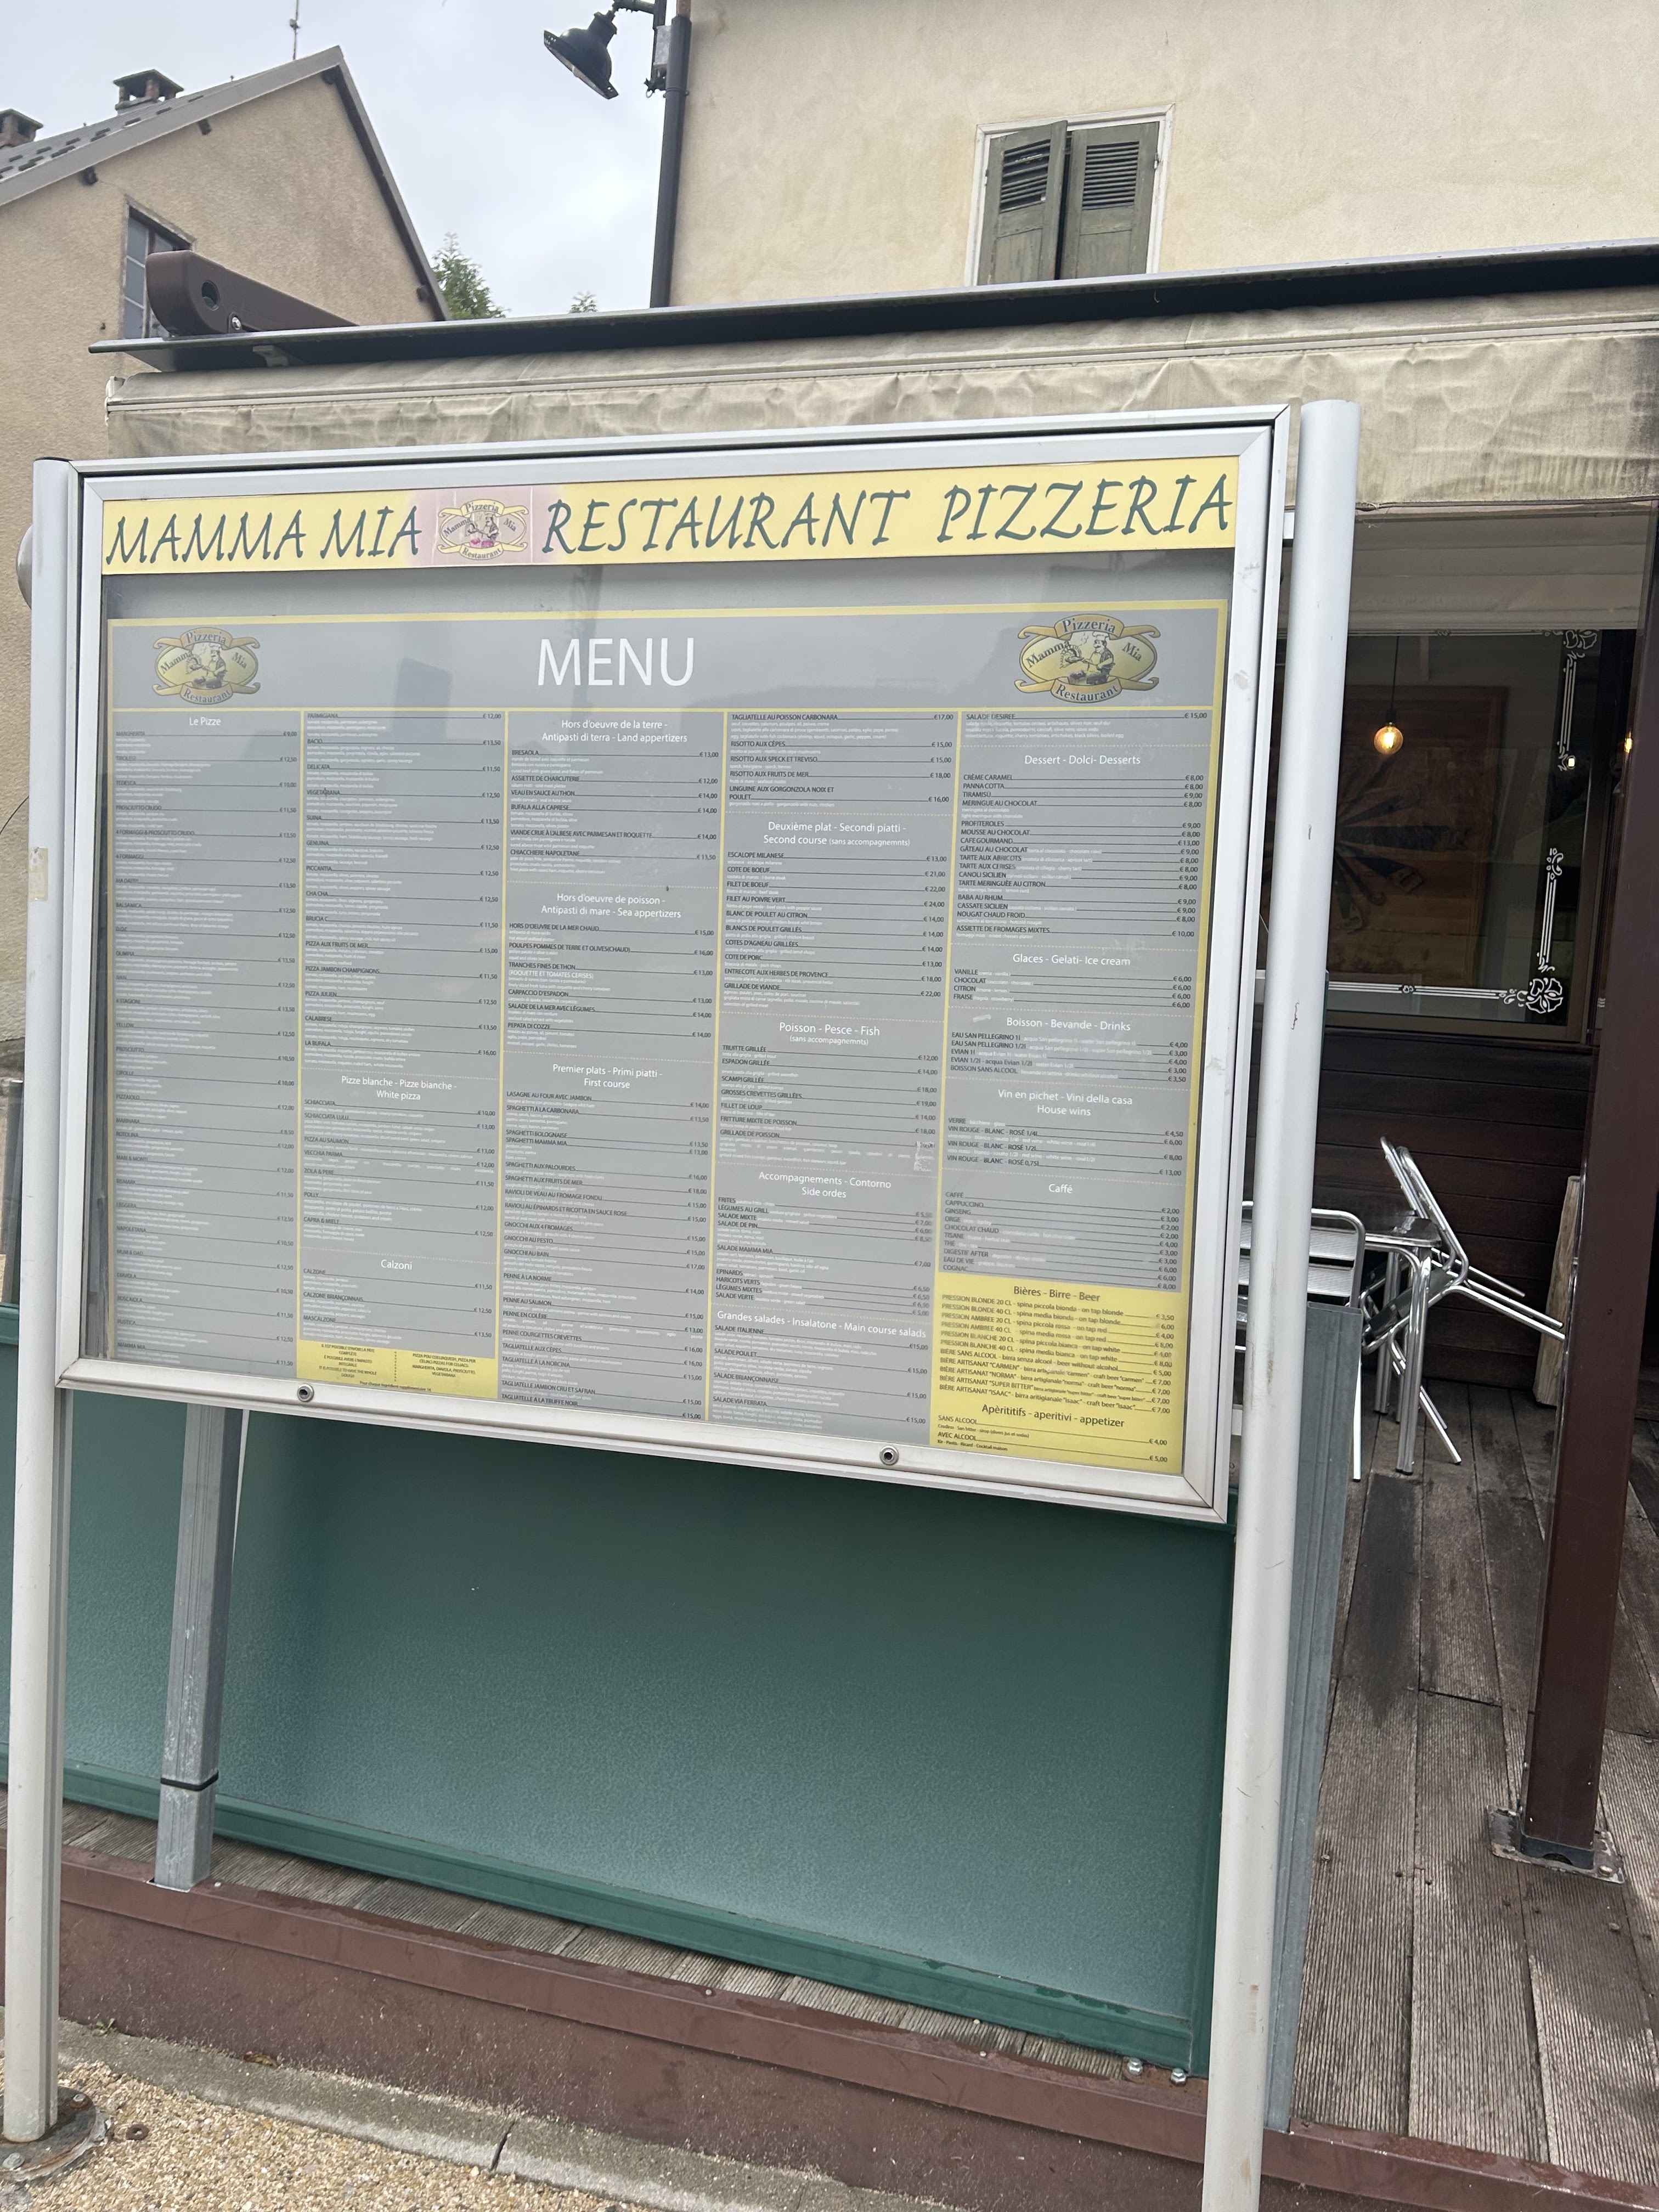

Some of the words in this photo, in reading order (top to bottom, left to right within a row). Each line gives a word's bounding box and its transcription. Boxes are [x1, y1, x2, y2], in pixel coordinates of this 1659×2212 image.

[465, 503, 499, 512] Pizzeria
[541, 488, 911, 554] RESTAURANT
[937, 473, 1233, 543] PIZZERIA
[443, 517, 473, 537] Mamma
[504, 517, 516, 532] Mia
[106, 509, 306, 565] MAMMA
[320, 505, 422, 561] MIA
[462, 548, 501, 558] Restaurant
[1062, 618, 1116, 633] Pizzeria
[186, 631, 226, 644] Pizzeria
[1025, 640, 1071, 668] Mamma
[1122, 642, 1142, 661] Mia
[160, 651, 194, 674] Mamma
[232, 652, 247, 669] Mia
[538, 637, 694, 686] MENU
[184, 689, 232, 703] Restaurant
[1056, 684, 1119, 701] Restaurant
[189, 717, 199, 725] Le
[200, 718, 222, 726] Pizze
[562, 720, 581, 729] Hors
[620, 720, 631, 729] de
[634, 720, 641, 729] la
[542, 733, 579, 742] Antipasti
[581, 733, 589, 741] di
[618, 733, 638, 742] Land
[640, 734, 688, 743] appertizers
[1025, 755, 1060, 765] Dessert
[1099, 755, 1141, 765] Desserts
[768, 822, 813, 832] Deuxième
[815, 822, 832, 832] plat
[840, 823, 875, 833] Secondi
[877, 823, 901, 833] piatti
[764, 835, 796, 845] Second
[798, 837, 827, 845] course
[557, 893, 576, 902] Hors
[616, 895, 627, 903] de
[628, 895, 661, 905] poisson
[541, 906, 578, 915] Antipasti
[618, 908, 633, 916] Sea
[634, 909, 681, 918] appertizers
[1013, 954, 1043, 963] Glaces
[1085, 956, 1098, 965] Ice
[1101, 958, 1131, 966] cream
[780, 1022, 816, 1033] Poisson
[825, 1024, 853, 1035] Pesce
[861, 1026, 880, 1036] Fish
[1007, 1018, 1042, 1027] Boisson
[1051, 1019, 1092, 1029] Bevande
[1101, 1022, 1131, 1031] Drinks
[553, 1064, 584, 1074] Premier
[586, 1065, 606, 1075] plats
[613, 1067, 635, 1077] Primi
[636, 1068, 658, 1077] piatti
[342, 1076, 361, 1085] Pizze
[363, 1077, 393, 1086] blanche
[399, 1079, 419, 1088] Pizze
[421, 1081, 453, 1090] bianche
[584, 1078, 601, 1087] First
[603, 1080, 631, 1088] course
[376, 1090, 399, 1099] White
[401, 1092, 421, 1101] pizza
[998, 1090, 1013, 1098] Vin
[1029, 1091, 1059, 1101] pichet
[1066, 1092, 1085, 1102] Vini
[1087, 1093, 1110, 1103] della
[1112, 1096, 1133, 1105] casa
[1037, 1105, 1067, 1115] House
[1069, 1107, 1091, 1115] wins
[759, 1171, 843, 1186] Accompagnements
[849, 1177, 891, 1189] Contorno
[802, 1187, 821, 1197] Side
[823, 1189, 847, 1198] ordes
[1049, 1183, 1073, 1194] Caffé
[381, 1260, 413, 1270] Calzoni
[1013, 1286, 1041, 1297] Bières
[1049, 1289, 1071, 1299] Birre
[1079, 1293, 1100, 1302] Beer
[717, 1311, 752, 1322] Grandes
[754, 1313, 786, 1325] salades
[792, 1317, 837, 1328] Insalatone
[844, 1322, 866, 1331] Main
[868, 1324, 897, 1335] course
[899, 1326, 927, 1338] salads
[973, 1351, 997, 1359] ALCOOL
[1034, 1409, 1071, 1423] aperitivi
[1080, 1414, 1124, 1429] appetizer
[938, 1431, 951, 1439] AVEC
[953, 1432, 977, 1441] ALCOOL
